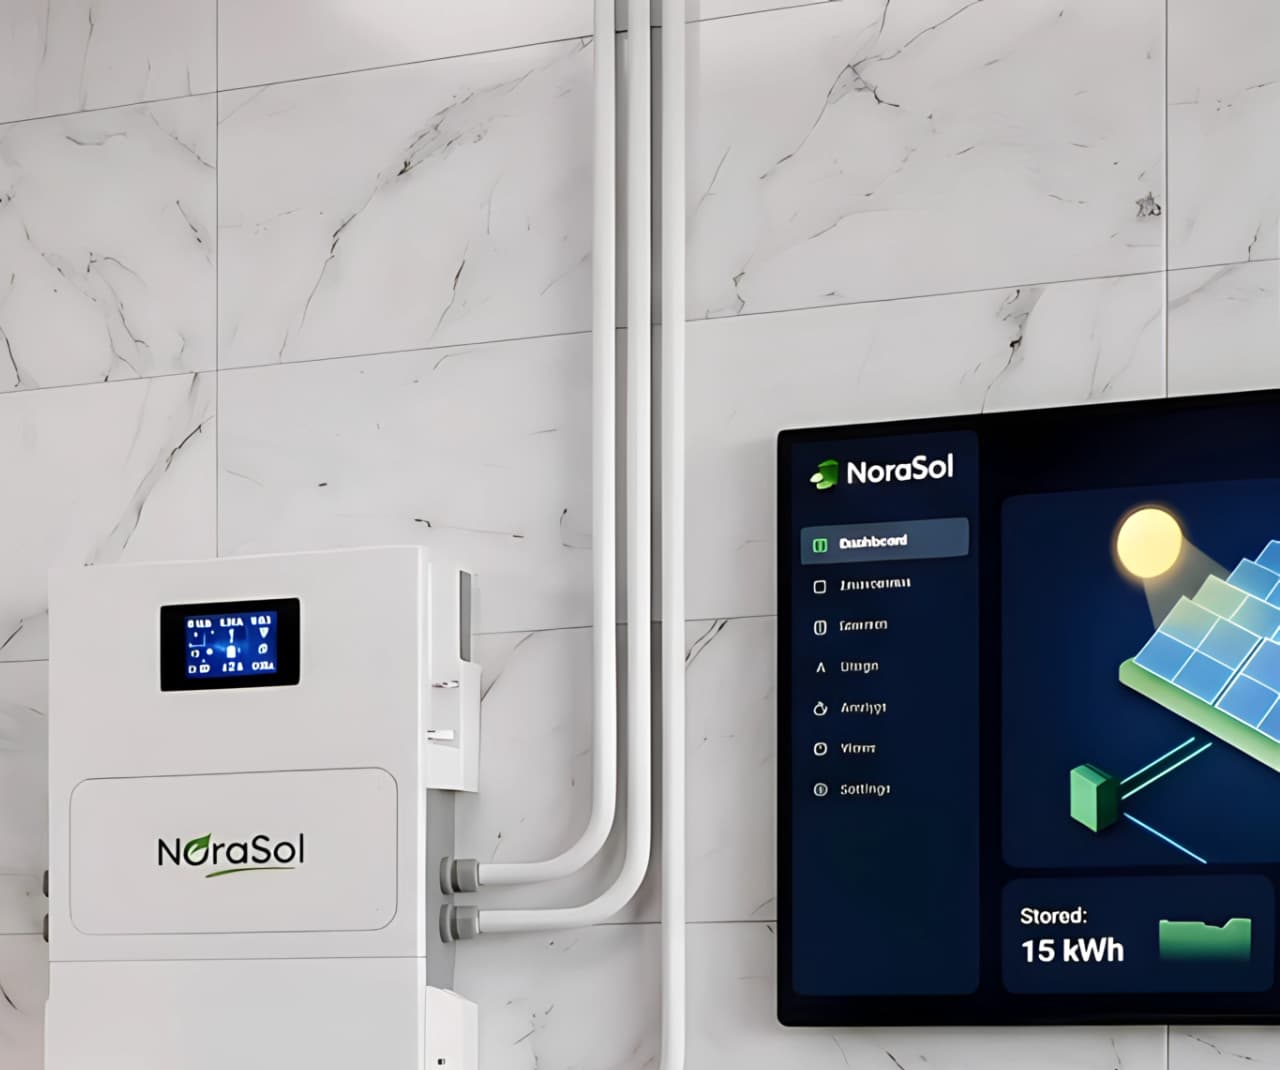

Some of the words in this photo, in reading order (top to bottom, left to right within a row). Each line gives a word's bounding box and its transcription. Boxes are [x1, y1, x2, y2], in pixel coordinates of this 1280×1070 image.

[847, 453, 954, 484] NoraSol
[158, 832, 305, 866] NoraSol
[1020, 906, 1088, 925] Stored:
[1021, 939, 1056, 963] 15
[1063, 937, 1124, 962] kWh
